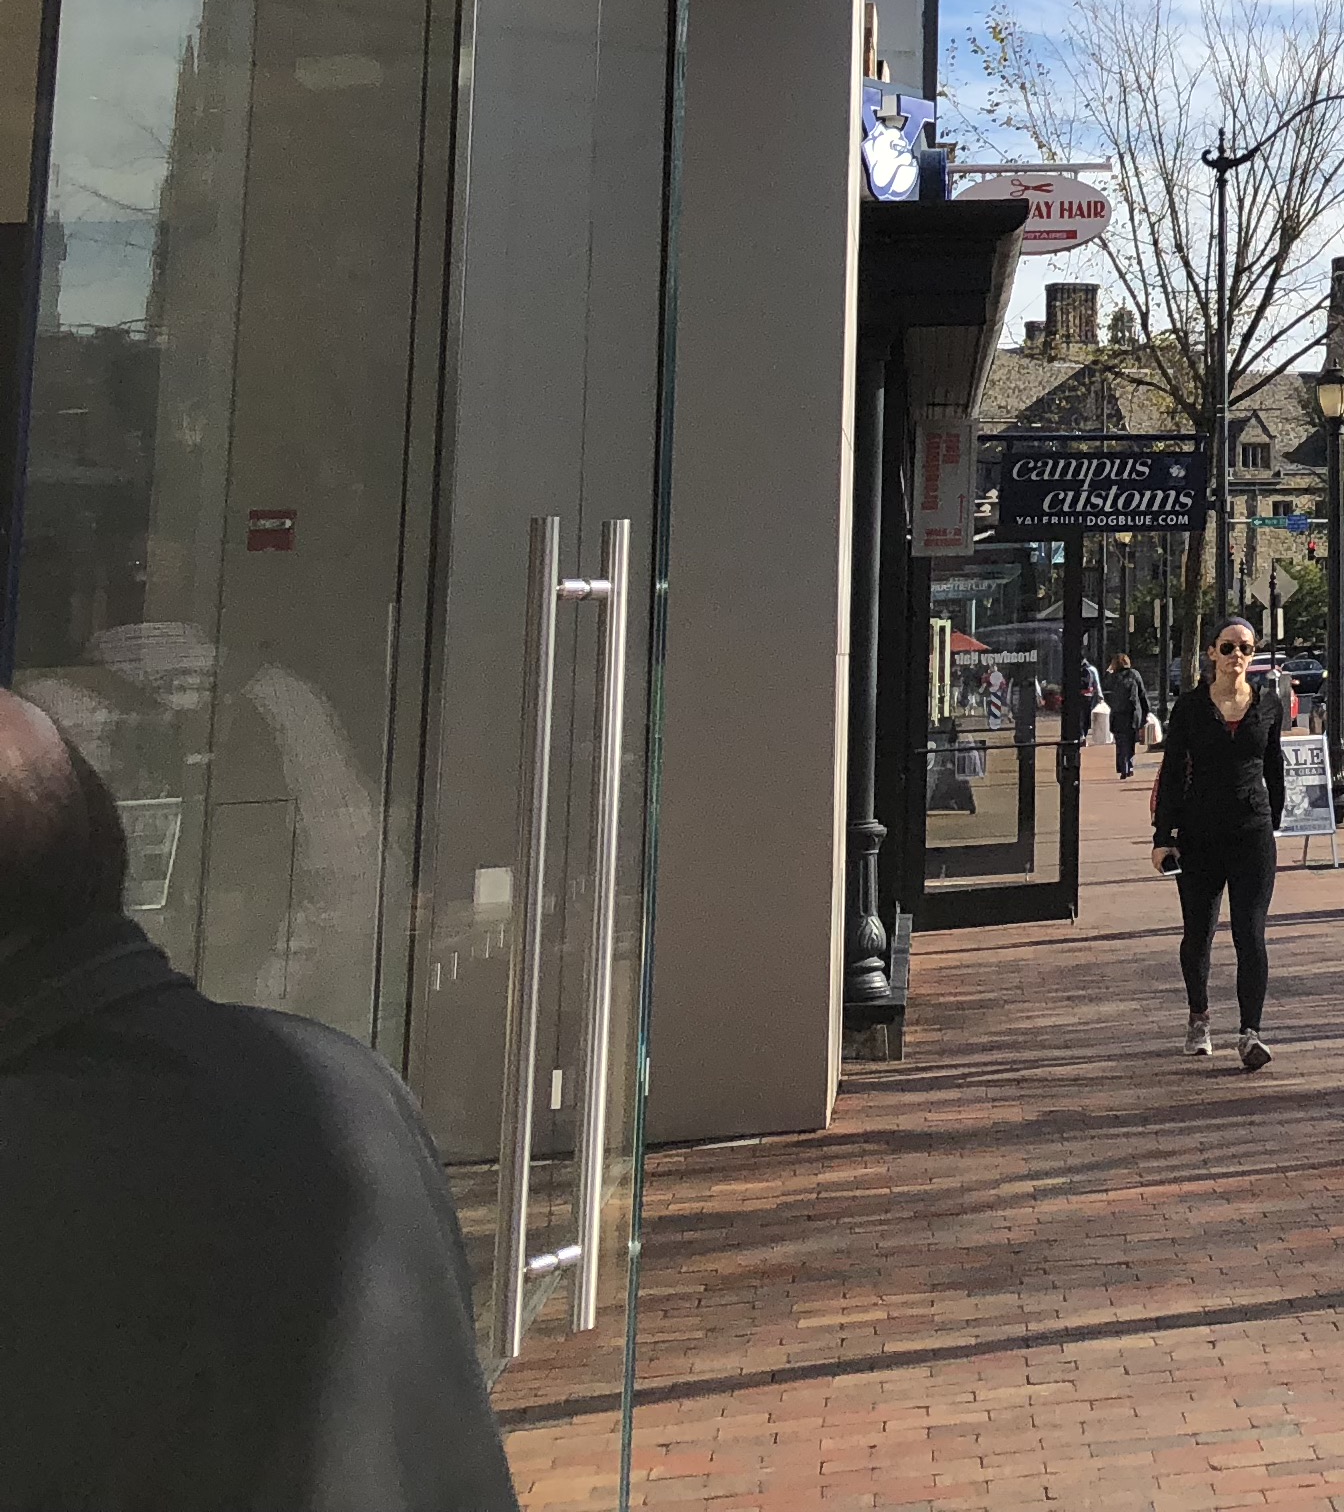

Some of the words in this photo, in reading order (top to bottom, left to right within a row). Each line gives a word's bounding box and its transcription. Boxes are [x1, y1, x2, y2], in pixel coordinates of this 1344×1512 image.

[1059, 200, 1105, 219] HAIR
[1012, 458, 1152, 489] campus
[1043, 485, 1195, 513] customs
